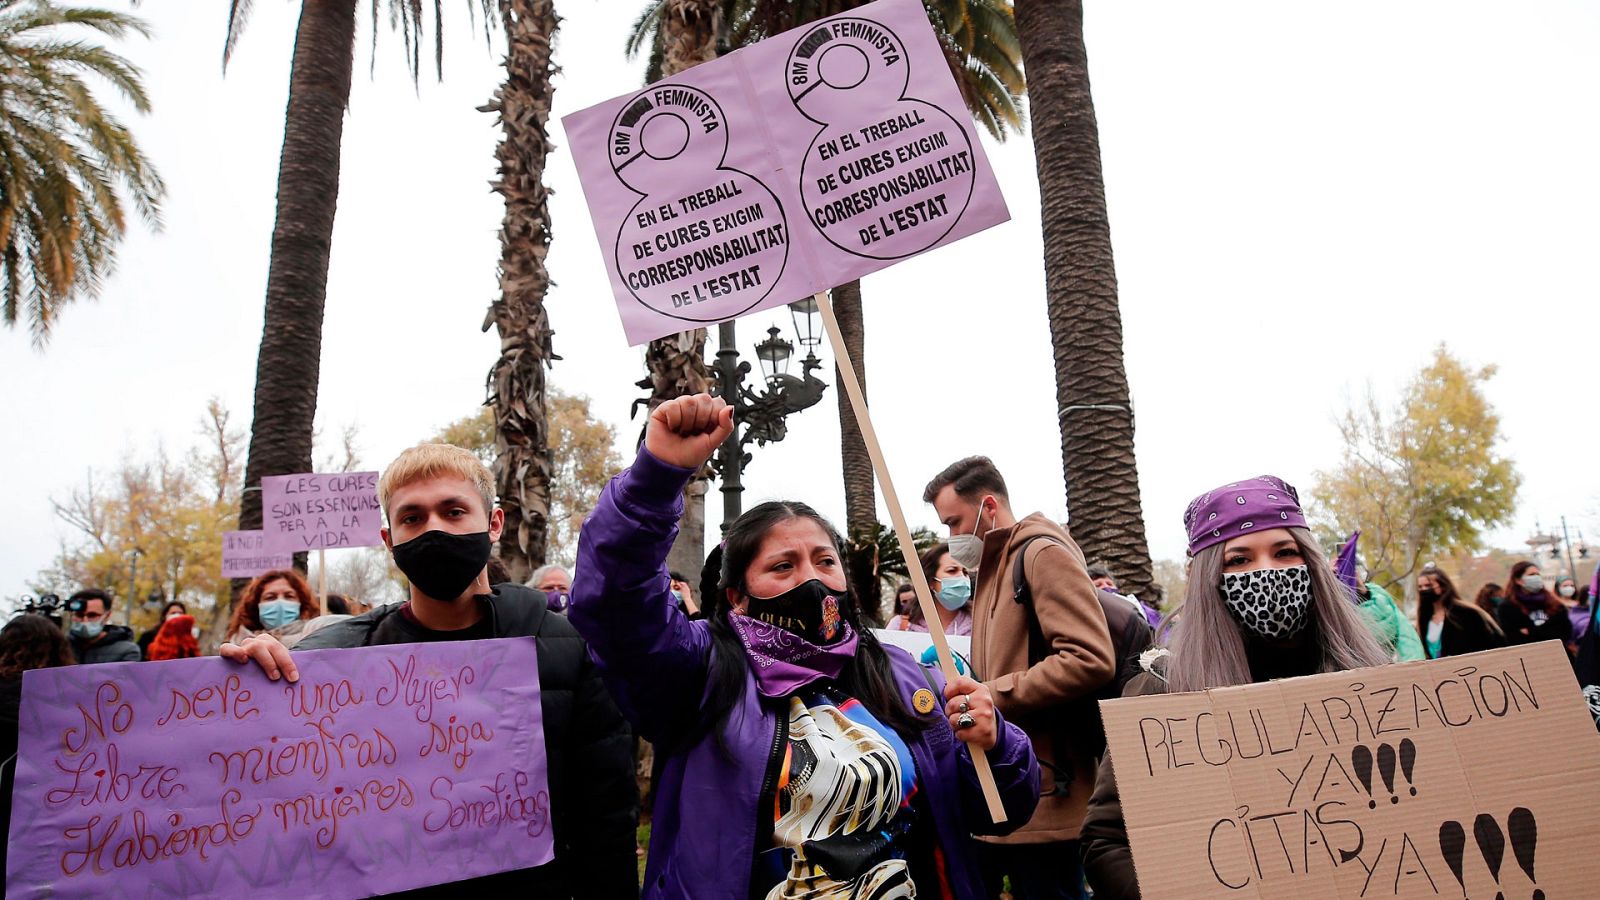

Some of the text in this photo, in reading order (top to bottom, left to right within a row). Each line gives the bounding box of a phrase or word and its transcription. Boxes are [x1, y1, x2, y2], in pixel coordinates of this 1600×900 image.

[792, 62, 809, 86] 8M
[832, 22, 900, 67] FEMINISTA
[615, 132, 631, 155] 8M
[654, 89, 719, 134] FEMINISTA
[818, 110, 925, 161] EN EL TREBALL
[814, 150, 971, 228] CORRESPONSABILITAT
[817, 131, 949, 195] DE CURES EXIGIM
[632, 203, 764, 260] DE CURES EXIGIM
[636, 179, 742, 229] EN EL TREBALL
[858, 193, 949, 246] DE L'ESTAT
[628, 224, 785, 290] CORRESPONSABILITAT
[671, 265, 762, 308] DE L'ESTAT
[272, 494, 381, 519] SON ESSENCIALS
[285, 476, 376, 494] LES CURES
[279, 515, 361, 532] PER A LA
[302, 531, 350, 547] VIDA
[64, 680, 134, 753] No
[284, 680, 364, 717] una
[46, 715, 495, 806] Libre mientras siga
[274, 778, 414, 848] mujeres
